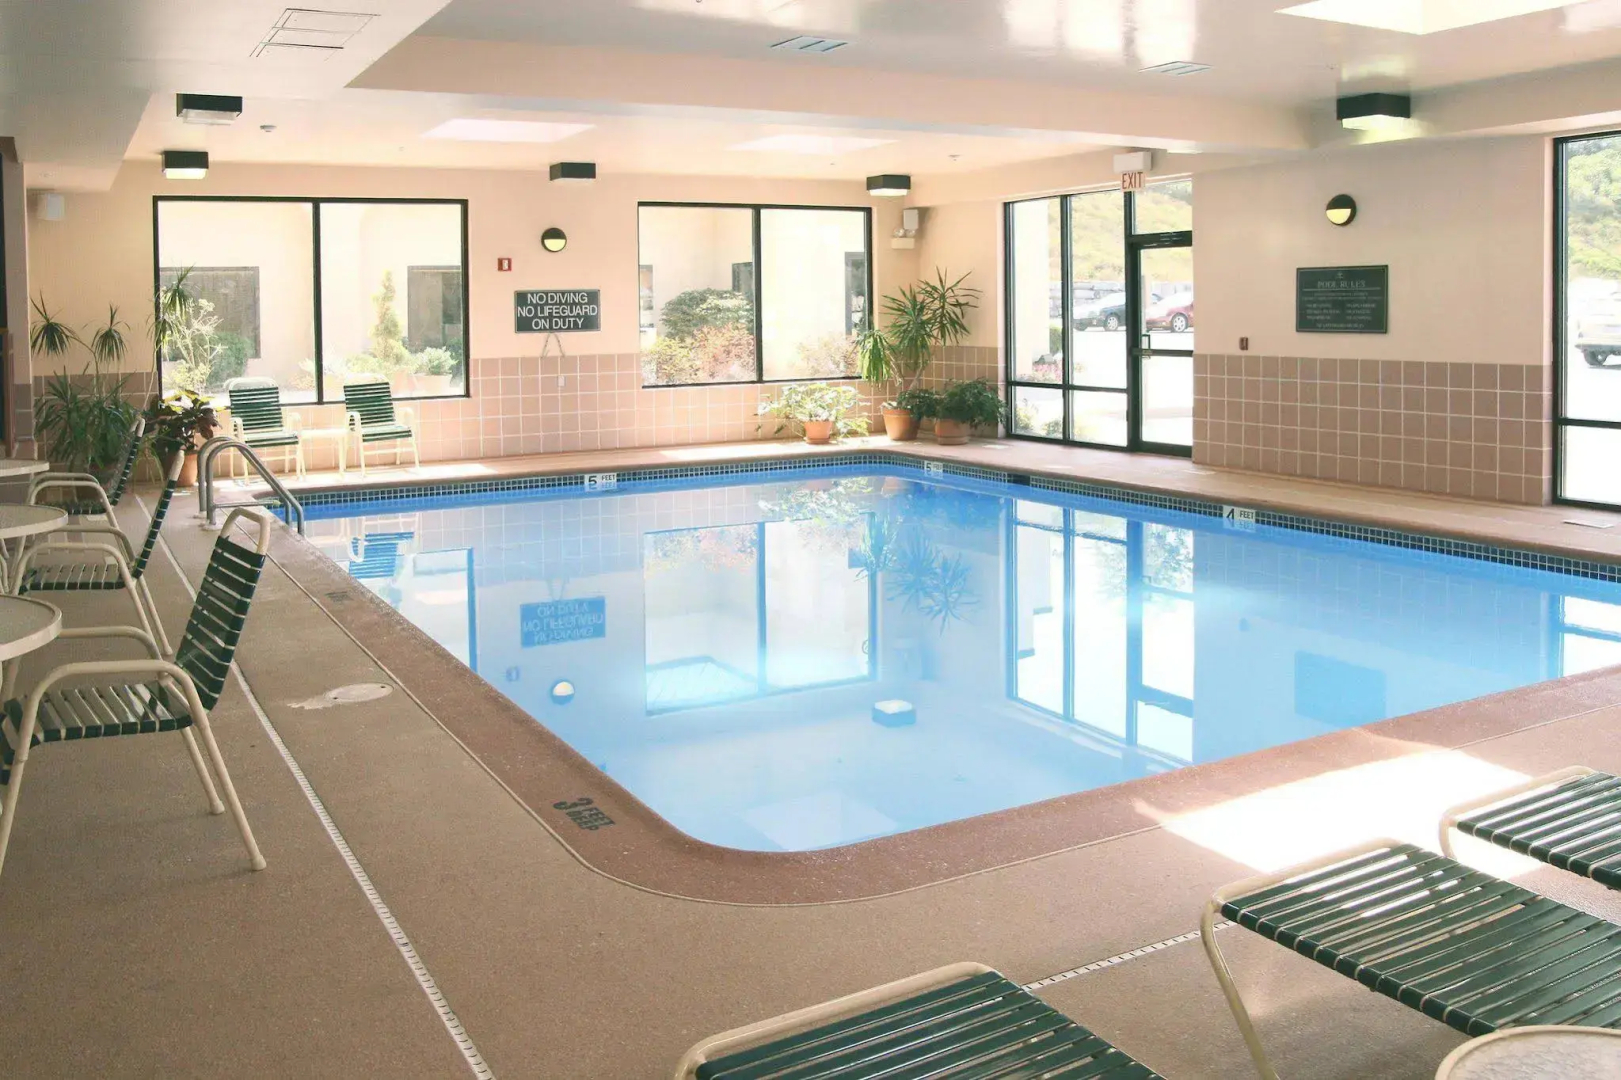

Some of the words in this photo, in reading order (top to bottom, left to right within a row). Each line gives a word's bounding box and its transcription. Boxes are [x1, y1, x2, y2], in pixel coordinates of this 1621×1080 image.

[1122, 172, 1143, 190] EXIT
[1317, 281, 1336, 289] POOL
[1340, 280, 1366, 288] RULES
[527, 293, 546, 304] NO
[548, 292, 588, 304] DIVING
[517, 306, 535, 317] NO
[537, 304, 598, 317] LIFEGUARD
[532, 318, 549, 330] ON
[552, 317, 584, 329] DUTY
[588, 475, 598, 484] 5
[1240, 510, 1254, 520] FEET
[553, 797, 594, 810] 3
[566, 811, 600, 831] DEEP
[581, 807, 616, 826] FEET
